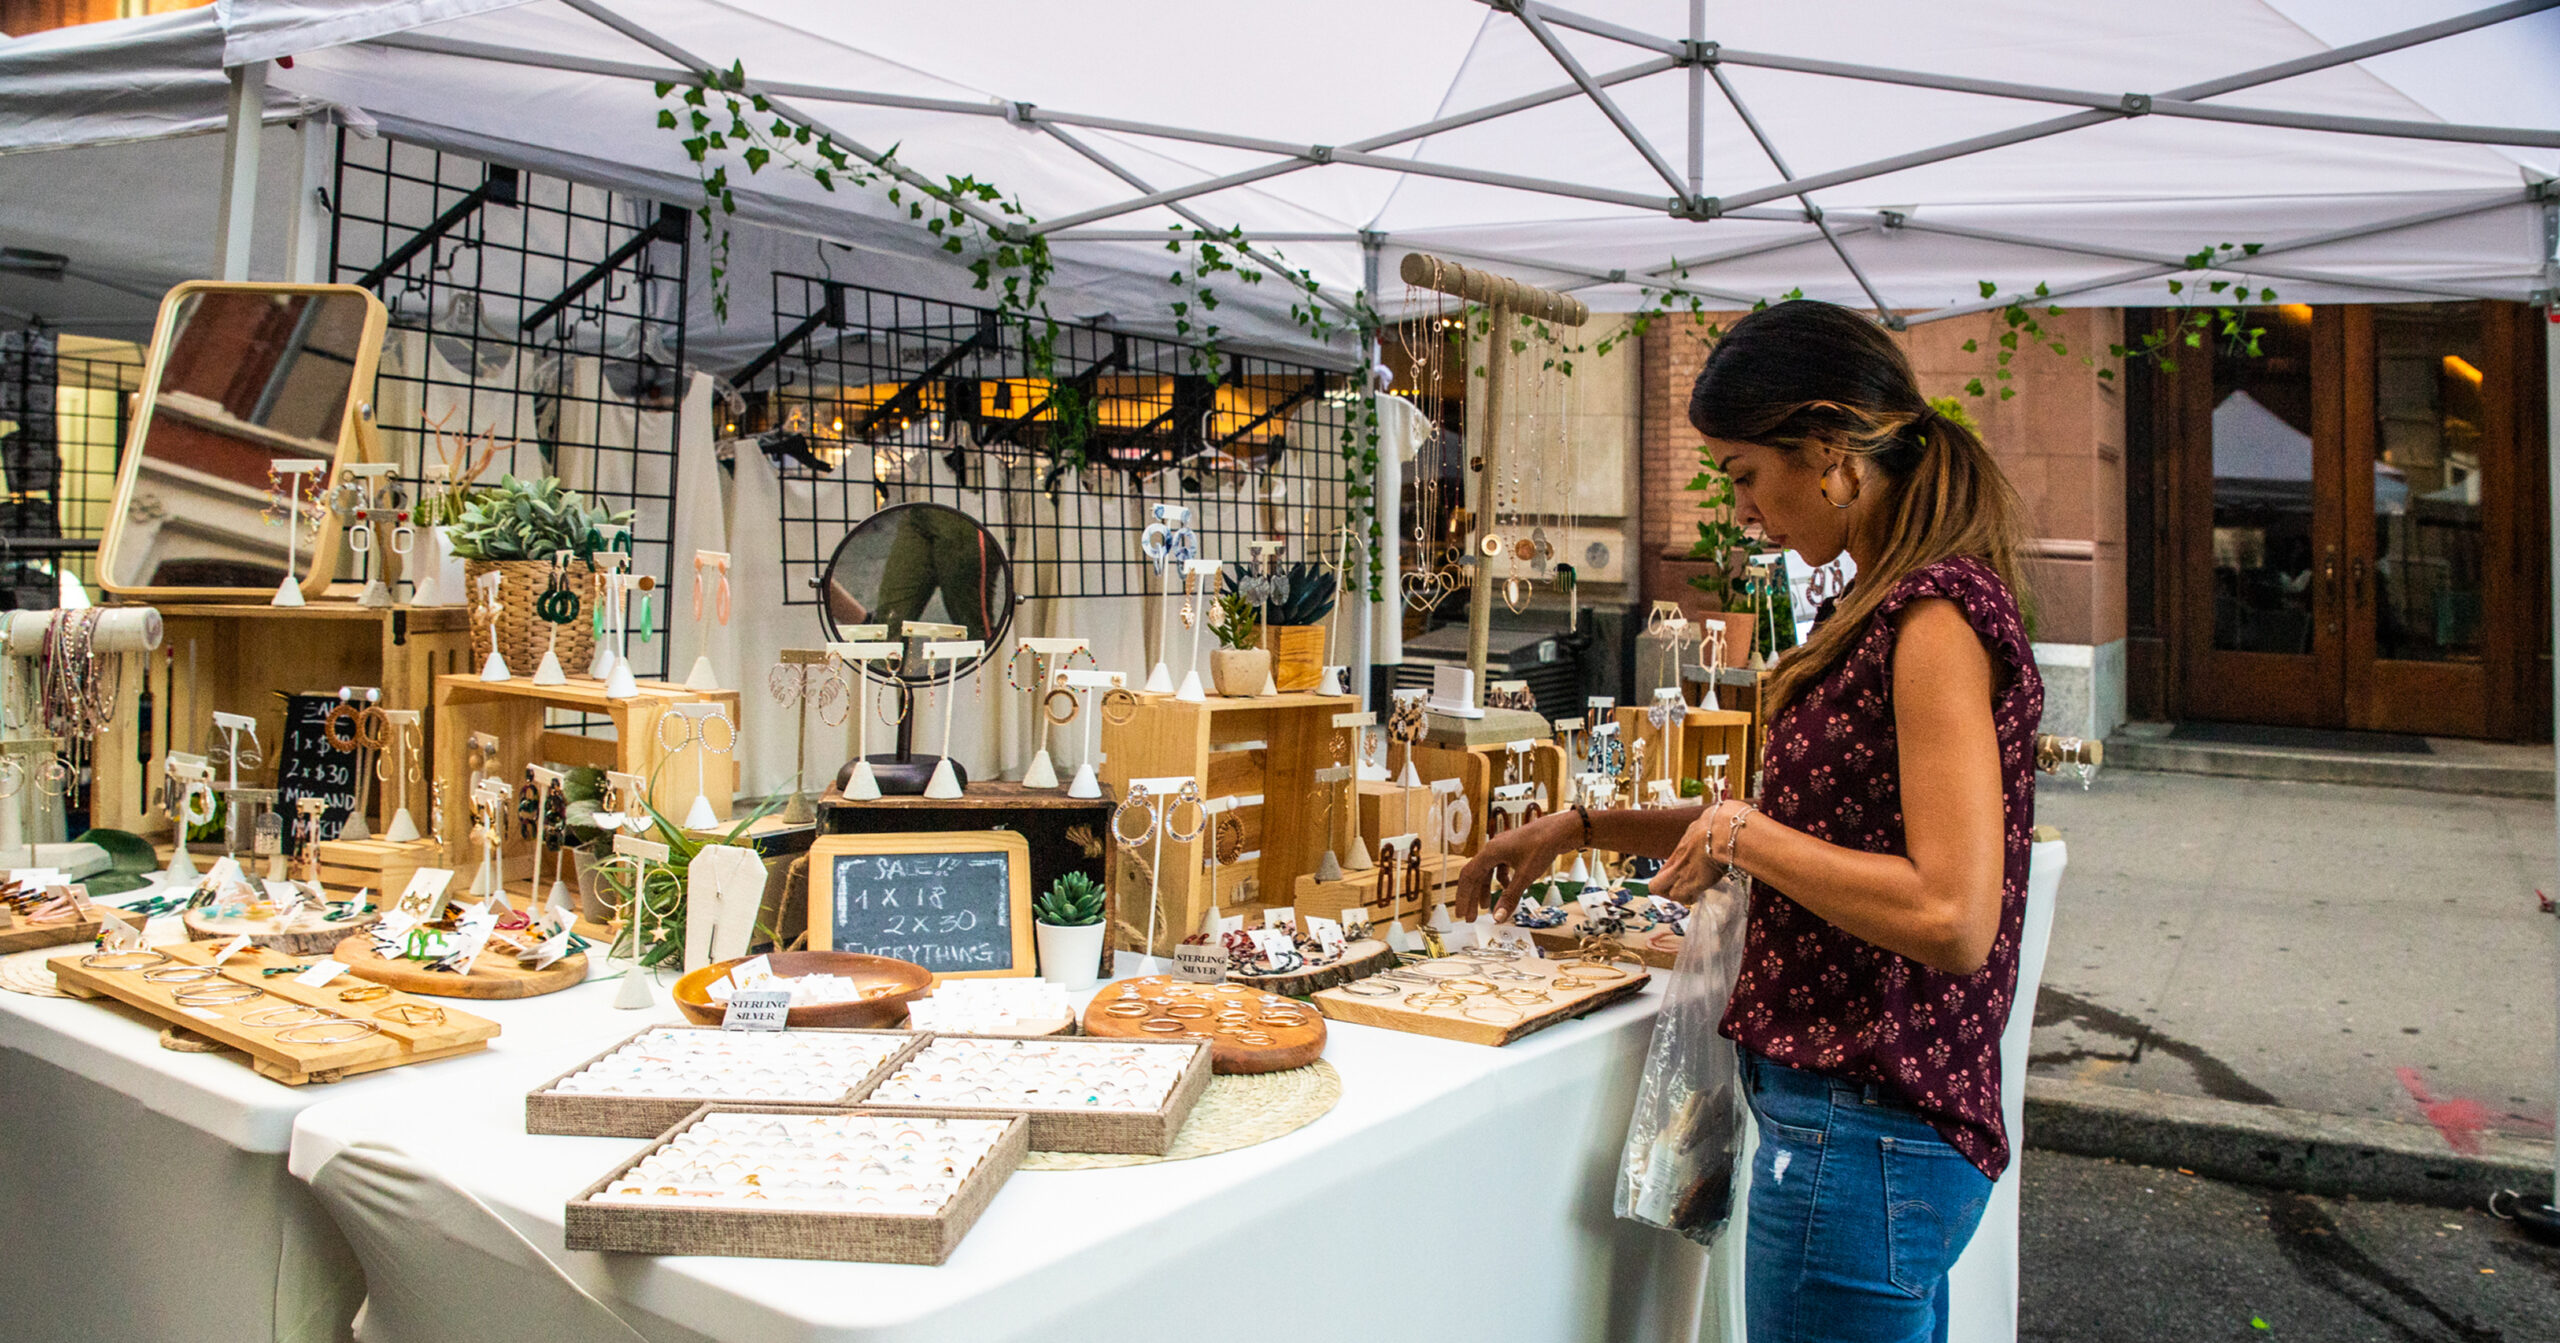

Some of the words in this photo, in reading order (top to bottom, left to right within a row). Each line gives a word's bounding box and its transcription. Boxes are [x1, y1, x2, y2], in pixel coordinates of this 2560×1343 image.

[290, 730, 300, 752] 1
[286, 758, 300, 778] 2
[315, 763, 349, 785] $30
[324, 792, 356, 812] AND
[855, 889, 868, 910] 1
[918, 886, 947, 910] 18
[883, 915, 905, 935] 2
[940, 909, 977, 933] 30
[1177, 954, 1225, 964] STERLING
[1182, 966, 1216, 975] SILVER
[731, 1000, 786, 1009] STERLING
[736, 1012, 775, 1020] SILVER
